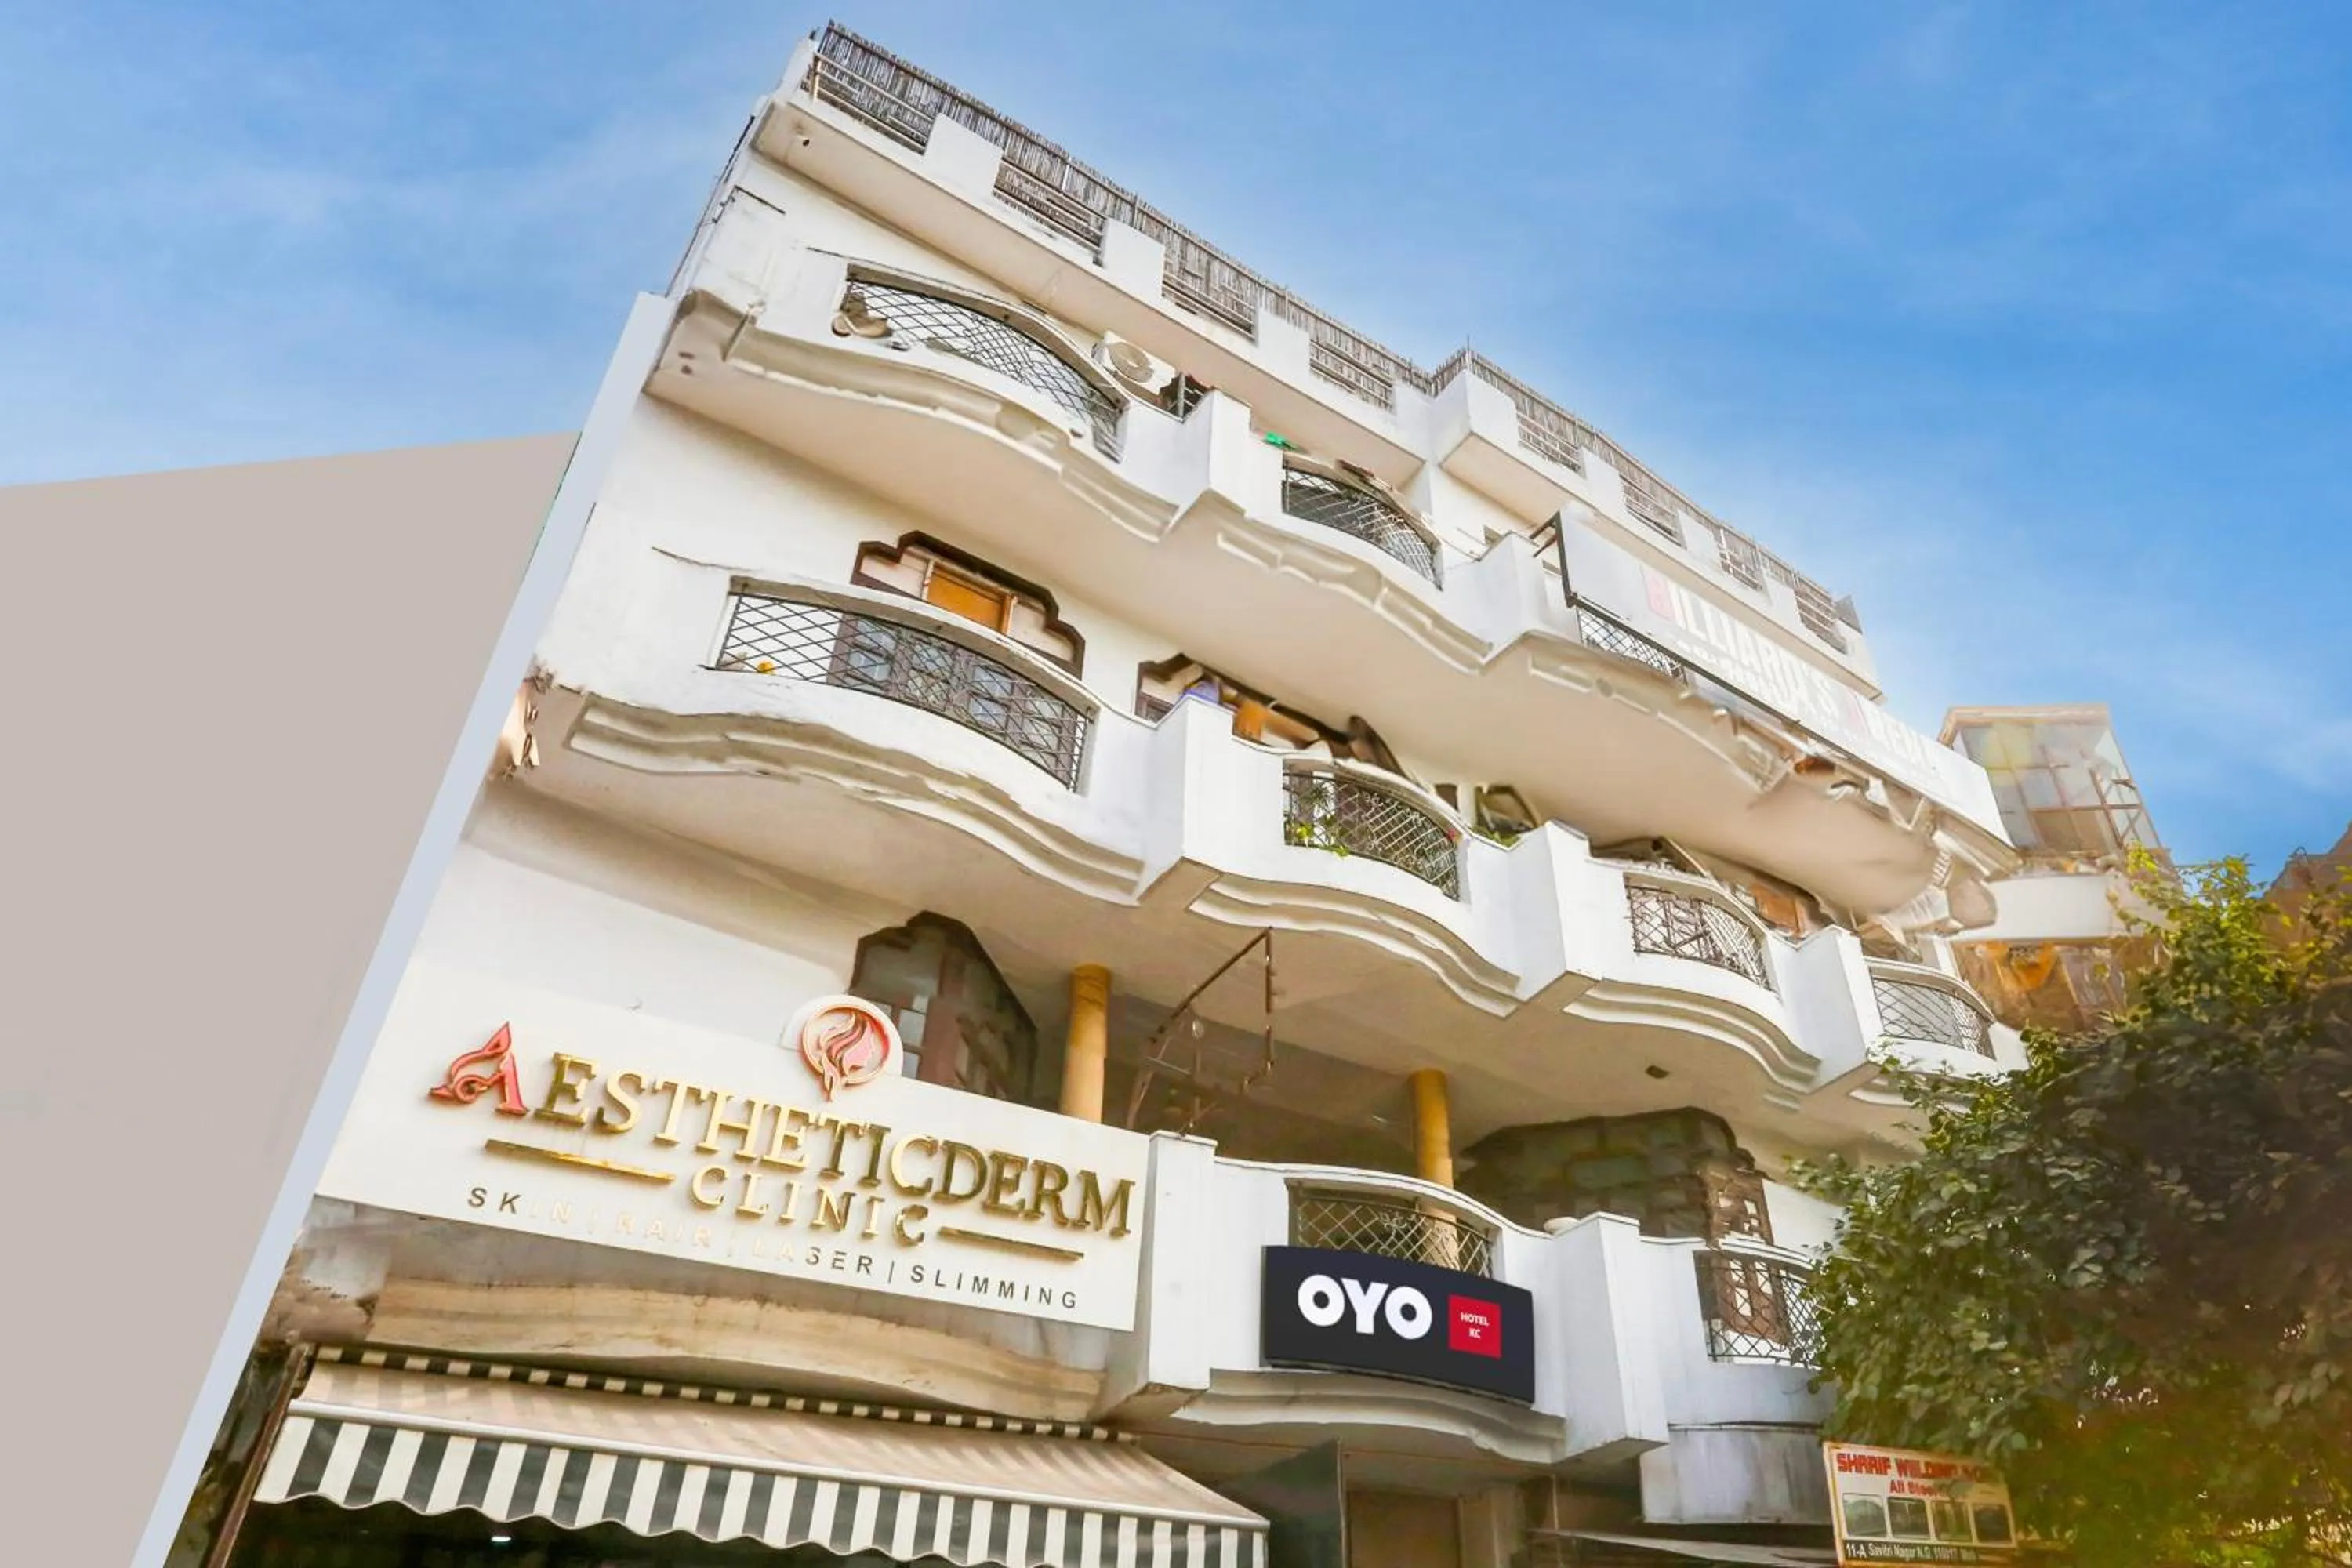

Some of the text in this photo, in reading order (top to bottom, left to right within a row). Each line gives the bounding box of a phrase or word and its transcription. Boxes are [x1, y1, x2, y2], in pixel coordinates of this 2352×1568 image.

[429, 1021, 1136, 1238] AESTHETICDERM
[691, 1165, 930, 1246] CLINIC
[909, 1265, 1079, 1309] SLIMMING
[1298, 1274, 1432, 1340] OYO
[1460, 1311, 1490, 1327] HOTEL
